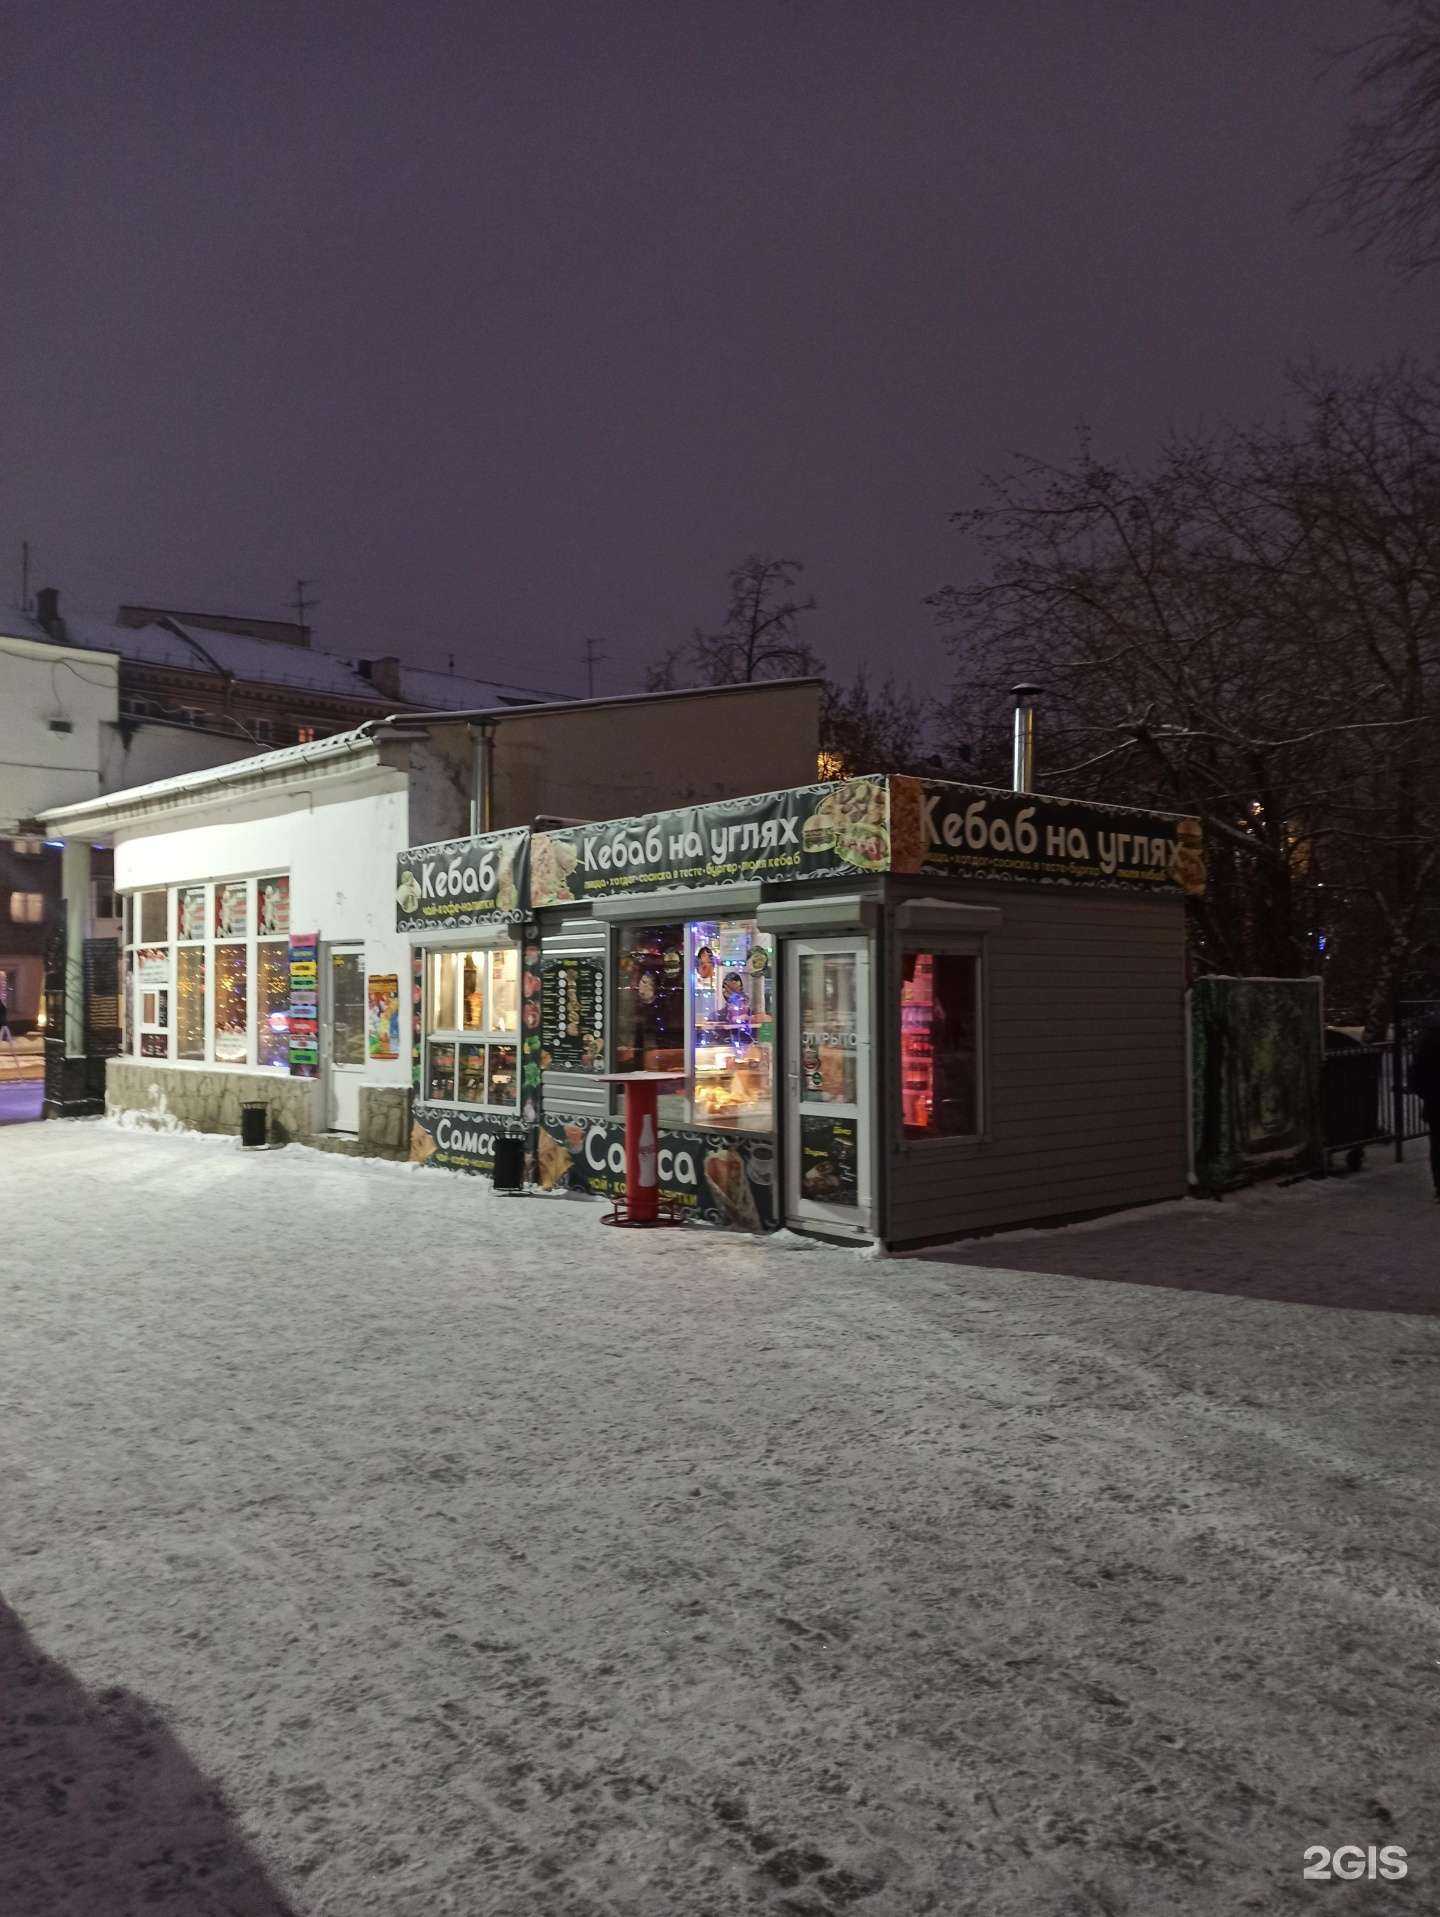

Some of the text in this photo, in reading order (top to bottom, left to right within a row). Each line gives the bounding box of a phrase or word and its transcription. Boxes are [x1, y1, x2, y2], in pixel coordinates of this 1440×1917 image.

[583, 816, 800, 872] Кебаб на углях
[768, 851, 801, 868] кебаб
[919, 794, 1184, 875] Кебаб на углях
[421, 851, 497, 898] Кебаб
[585, 1125, 698, 1185] Саса
